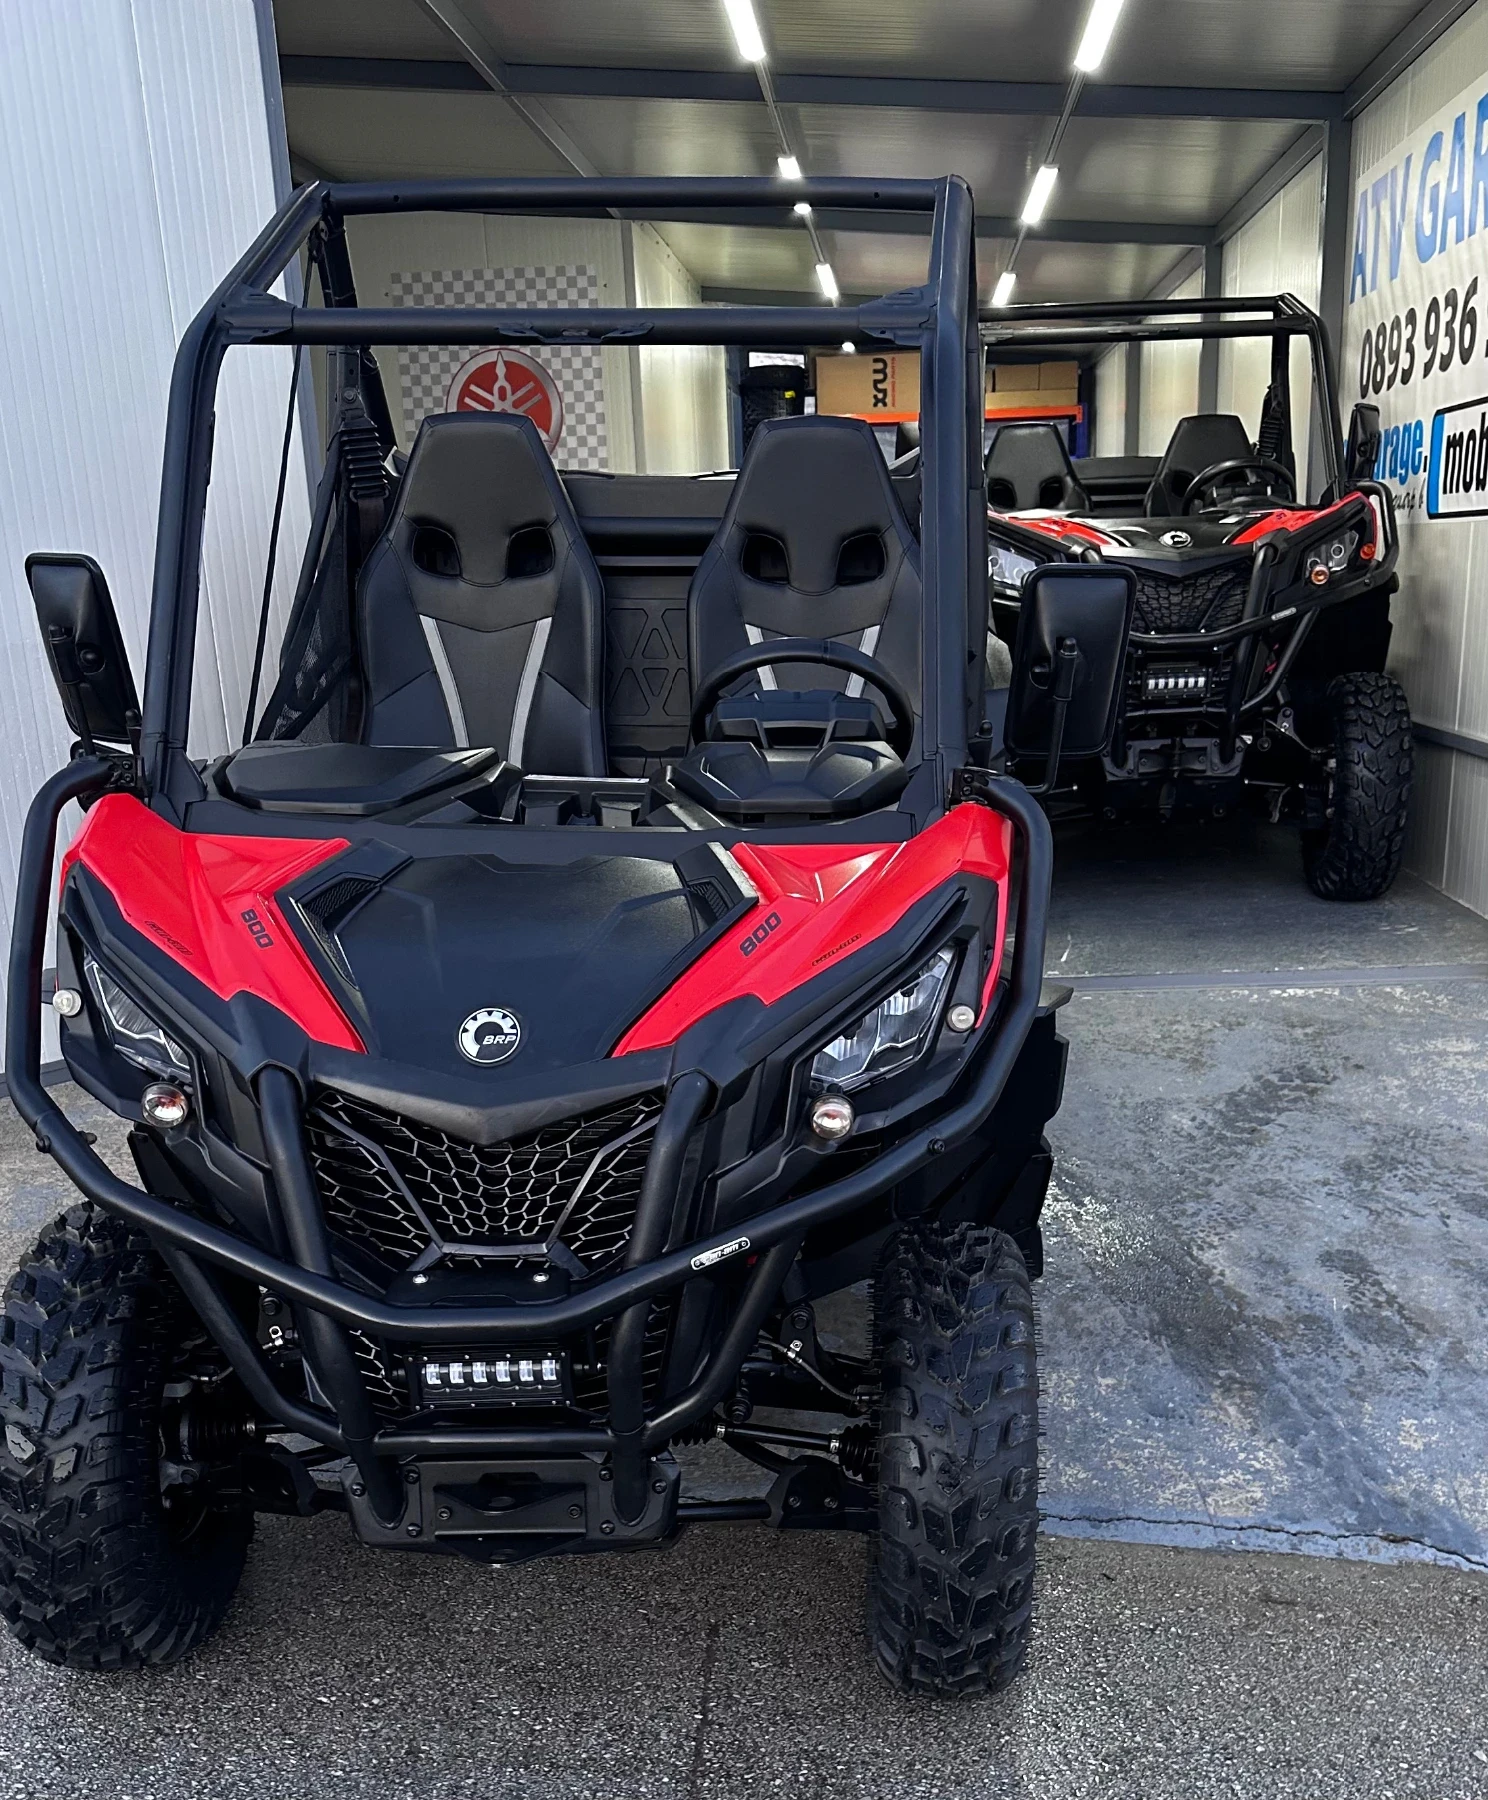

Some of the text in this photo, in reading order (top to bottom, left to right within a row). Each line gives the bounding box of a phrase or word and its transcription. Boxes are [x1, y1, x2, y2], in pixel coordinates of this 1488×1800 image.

[1350, 153, 1413, 303] ATV
[1360, 307, 1417, 399] 0893
[1423, 276, 1478, 379] 936
[241, 908, 274, 948] 800
[740, 911, 782, 957] 800
[482, 1034, 517, 1045] BRP
